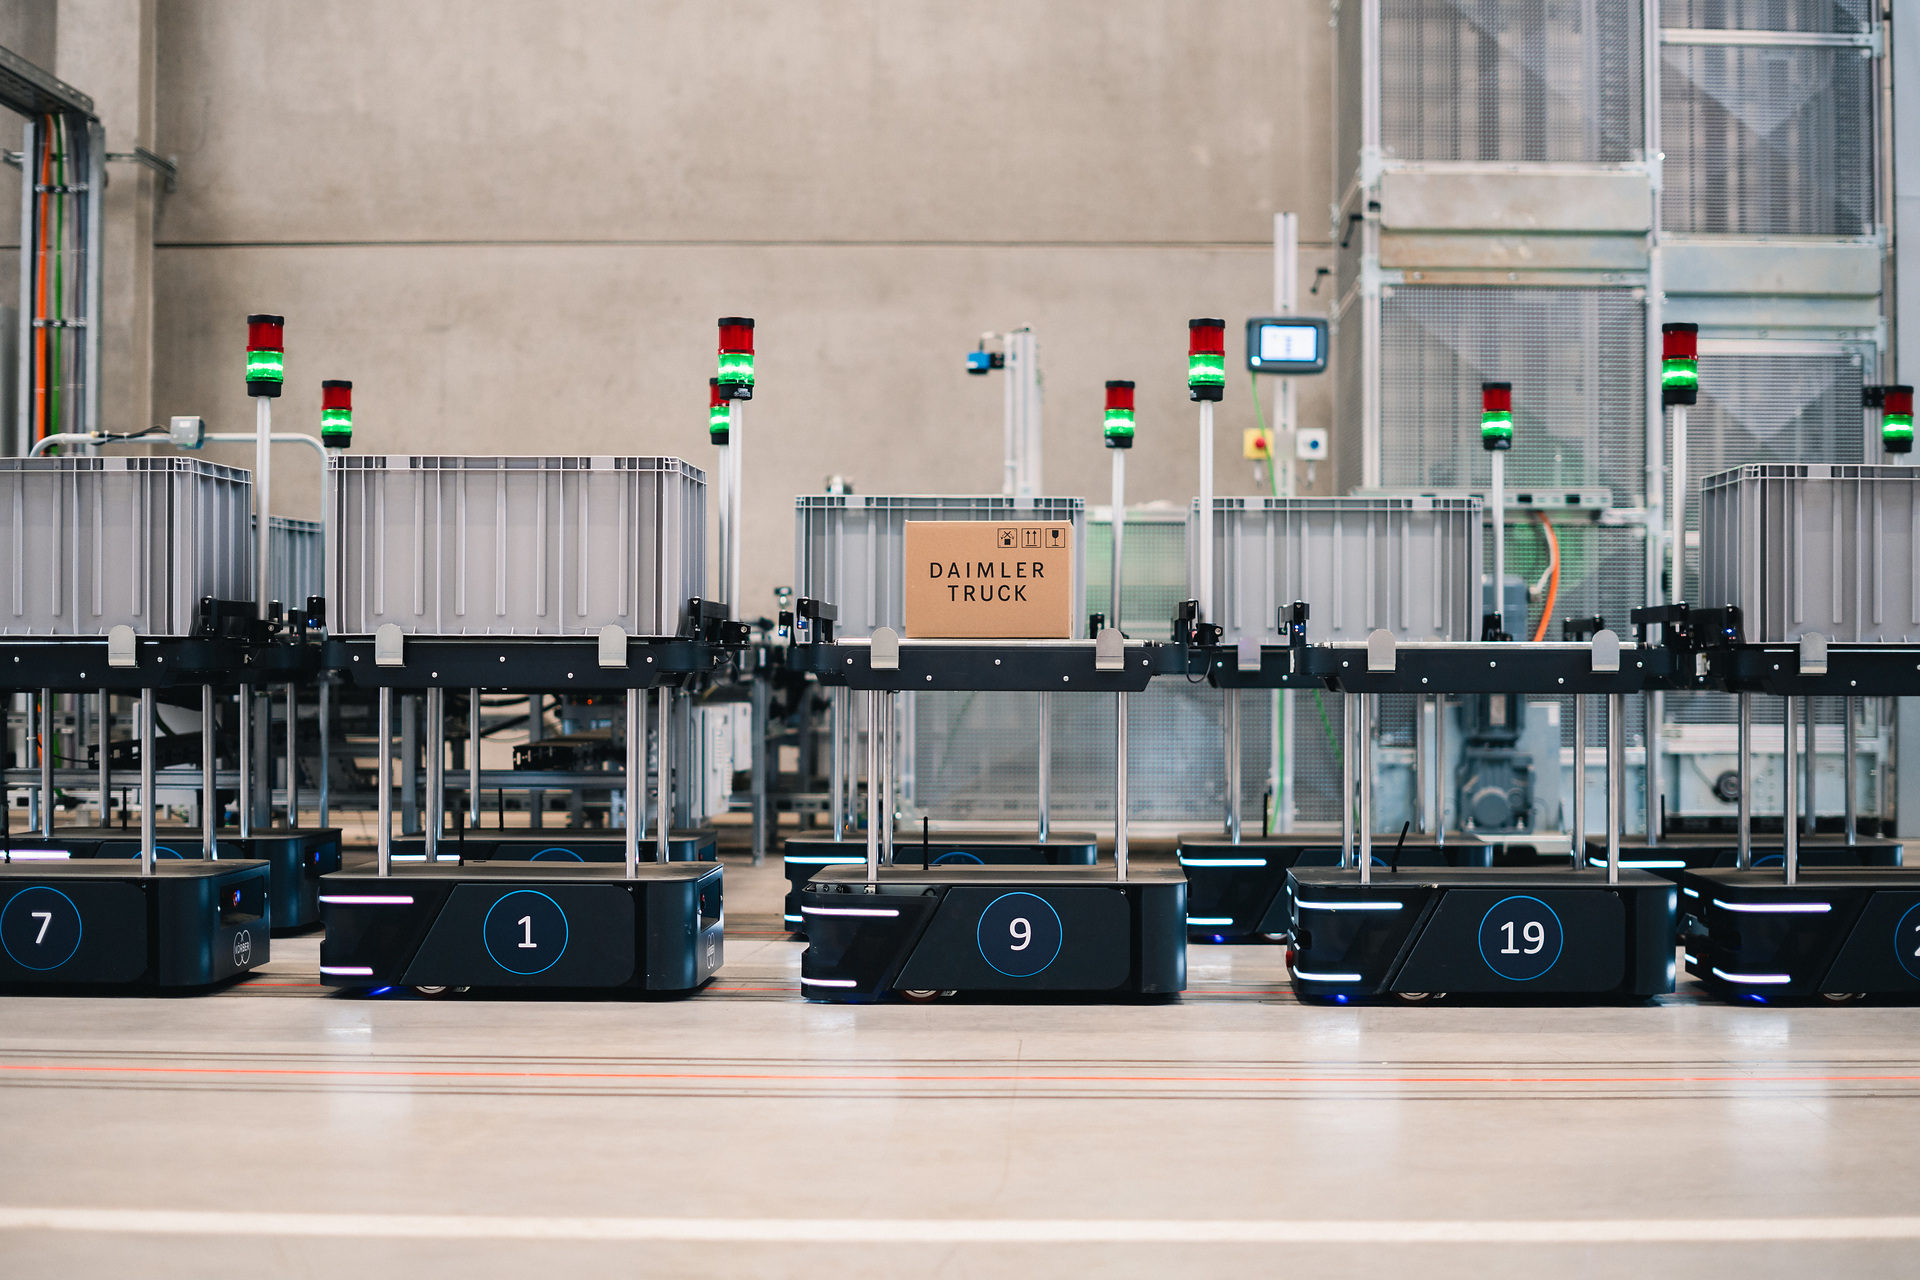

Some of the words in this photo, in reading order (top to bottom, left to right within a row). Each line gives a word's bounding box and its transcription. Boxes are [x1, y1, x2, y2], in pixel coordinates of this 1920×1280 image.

[929, 562, 1045, 579] DAIMLER
[947, 585, 1027, 602] TRUCK
[31, 911, 52, 944] 7
[517, 915, 538, 948] 1
[1009, 917, 1032, 951] 9
[1500, 921, 1545, 955] 19
